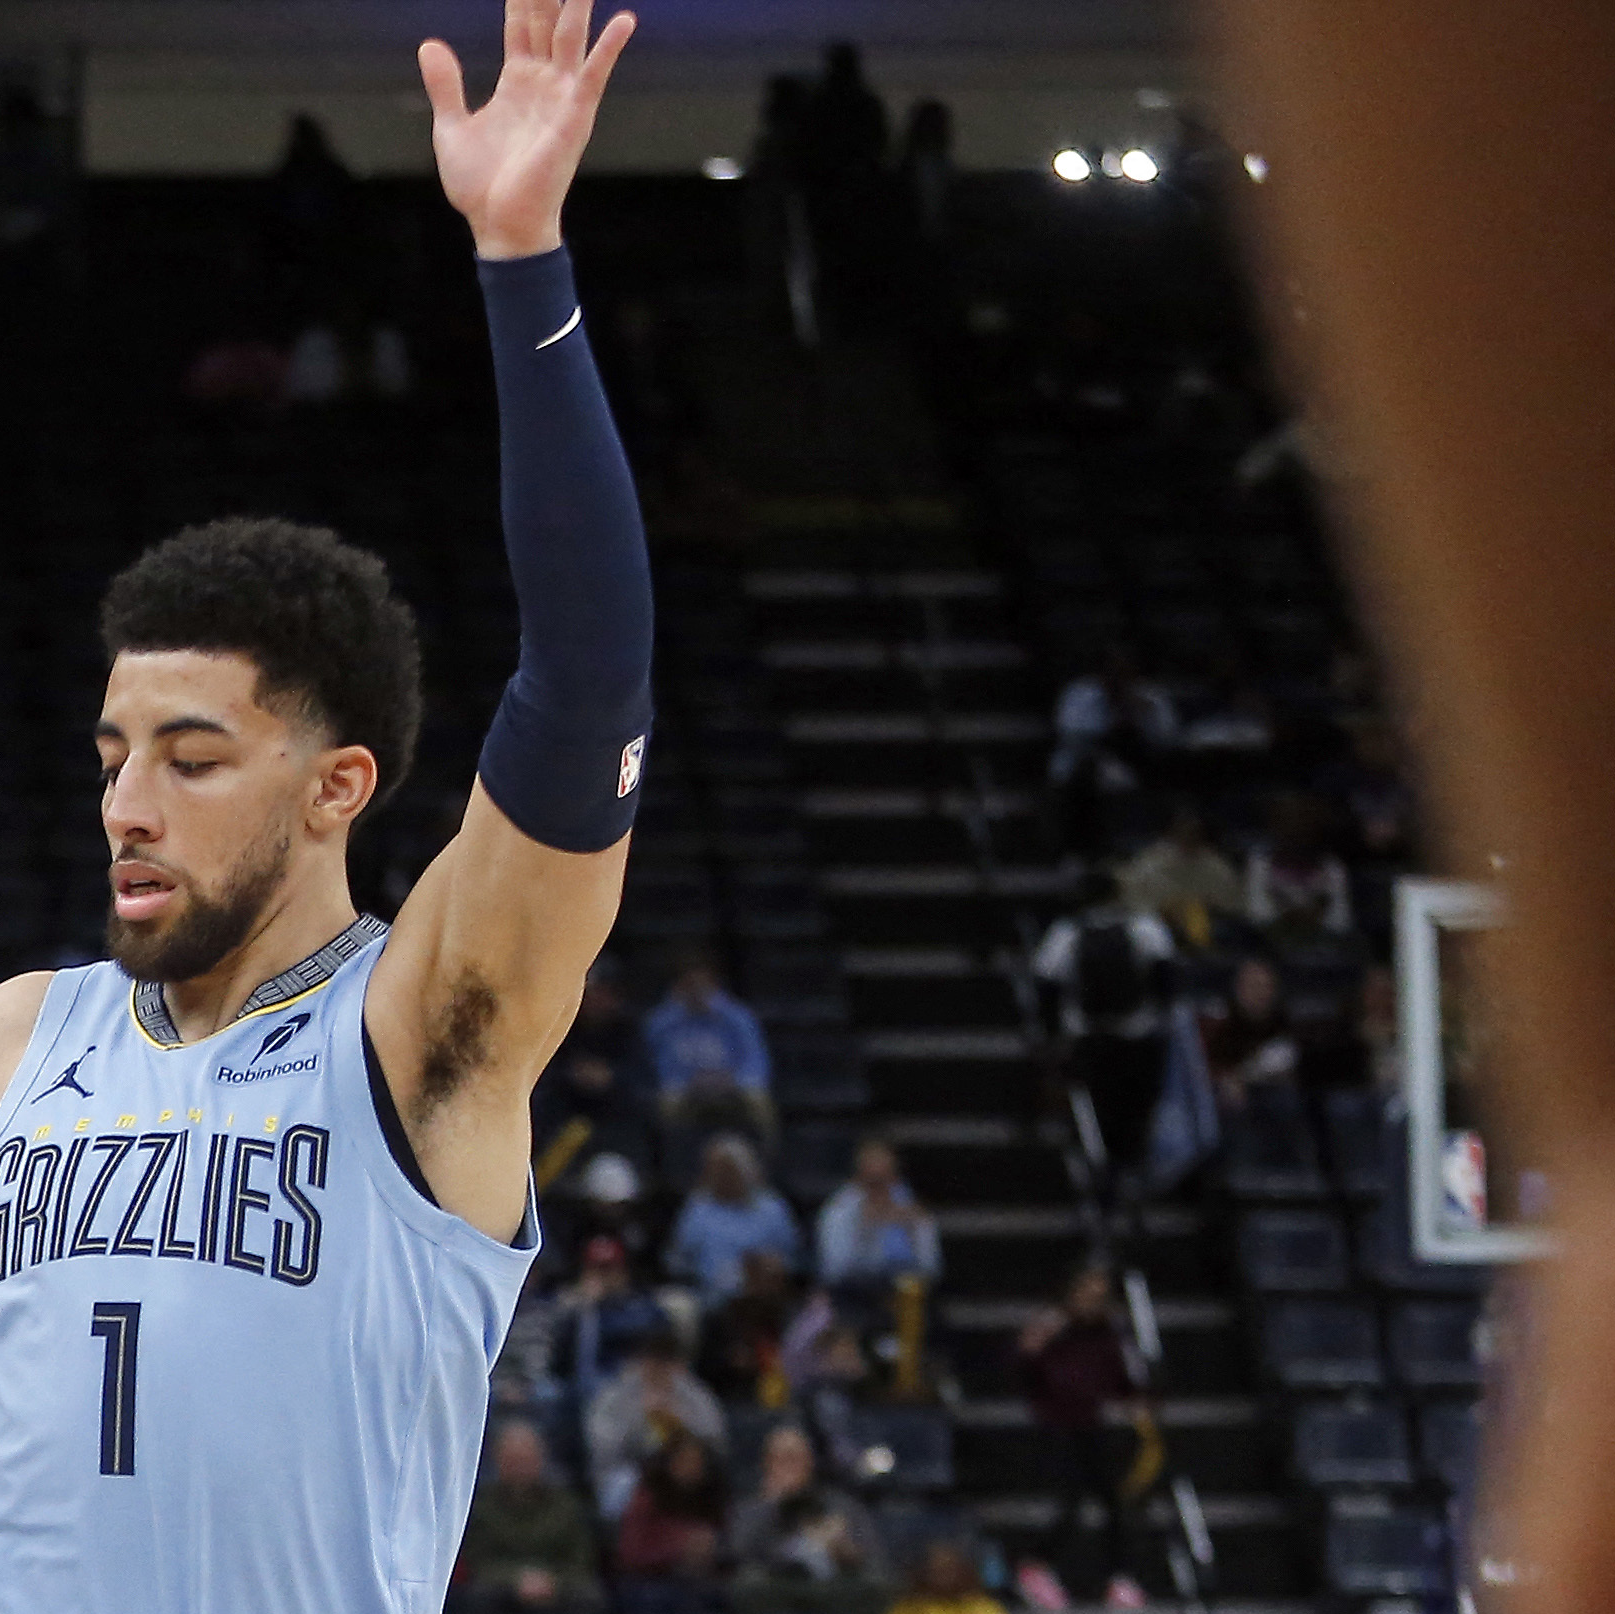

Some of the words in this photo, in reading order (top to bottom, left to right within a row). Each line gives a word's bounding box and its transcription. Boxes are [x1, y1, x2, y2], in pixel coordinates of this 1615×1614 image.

[217, 1054, 318, 1085] Robinhood
[32, 1107, 279, 1142] MEMPHIS
[90, 1301, 142, 1476] 1
